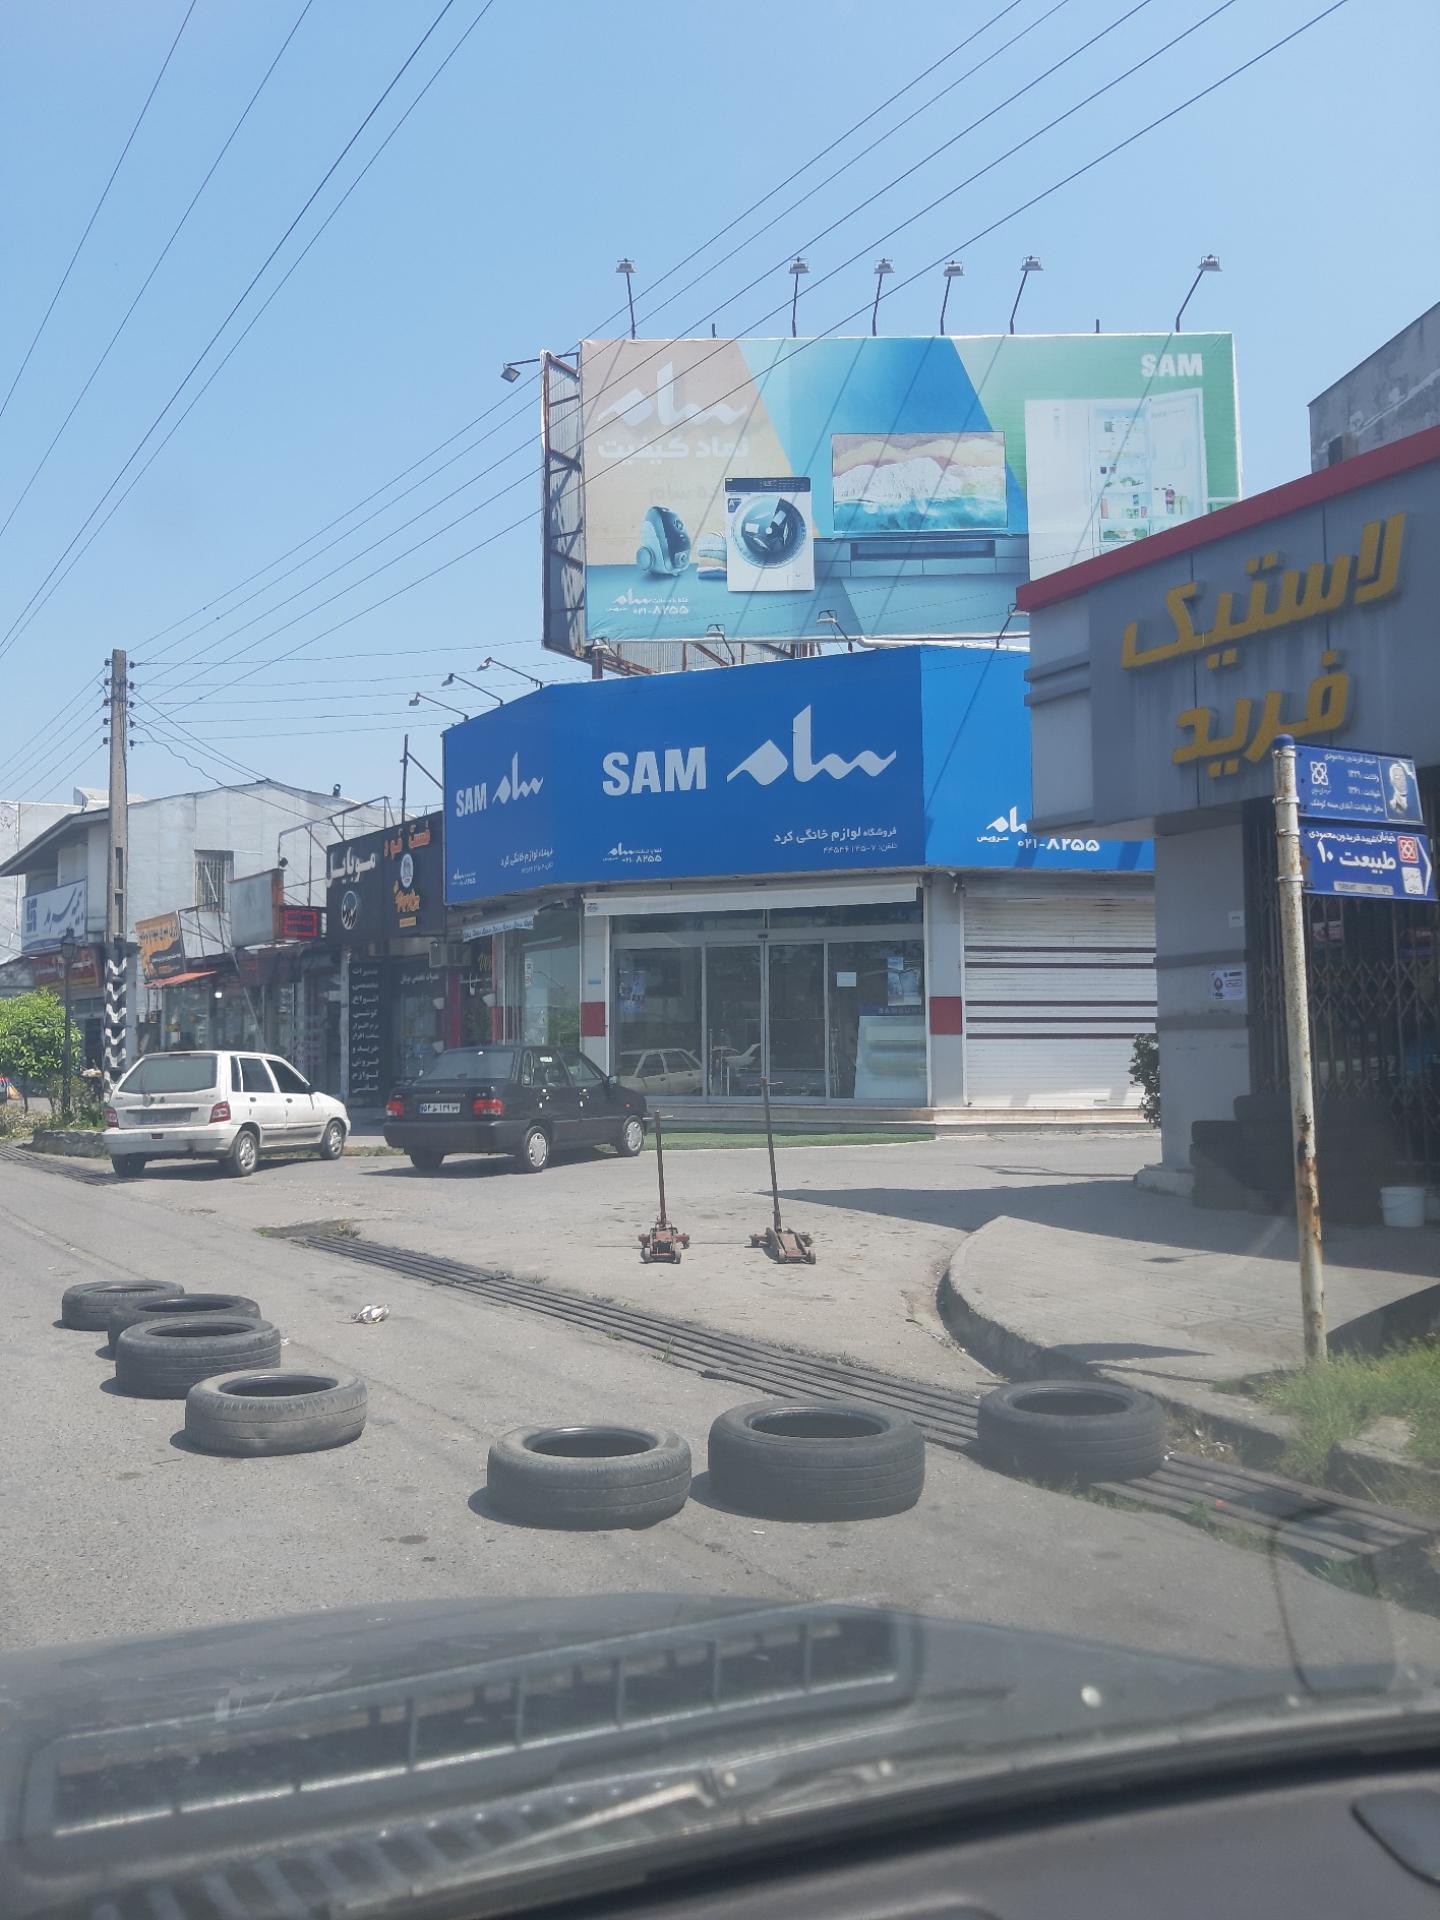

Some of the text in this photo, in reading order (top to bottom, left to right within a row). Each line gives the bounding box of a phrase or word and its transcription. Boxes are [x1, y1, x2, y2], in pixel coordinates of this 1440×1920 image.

[1141, 353, 1202, 377] SAM
[597, 361, 748, 427] سام
[1121, 512, 1407, 670] لاستیک
[1173, 649, 1352, 777] فرید
[726, 704, 897, 786] سام
[492, 751, 544, 806] سام
[603, 746, 706, 796] SAM
[455, 782, 487, 818] SAM
[608, 842, 634, 856] سام
[773, 825, 897, 845] فروشگاه لوازم خانگی کرد
[1017, 837, 1100, 852] ۰۲۱-۸۲۵۵
[1309, 830, 1336, 841] محمودی
[1337, 832, 1358, 844] فریدون
[1377, 831, 1396, 844] خیابان
[326, 847, 376, 888] موبایل
[1317, 840, 1397, 874] طبیعت ۱۰
